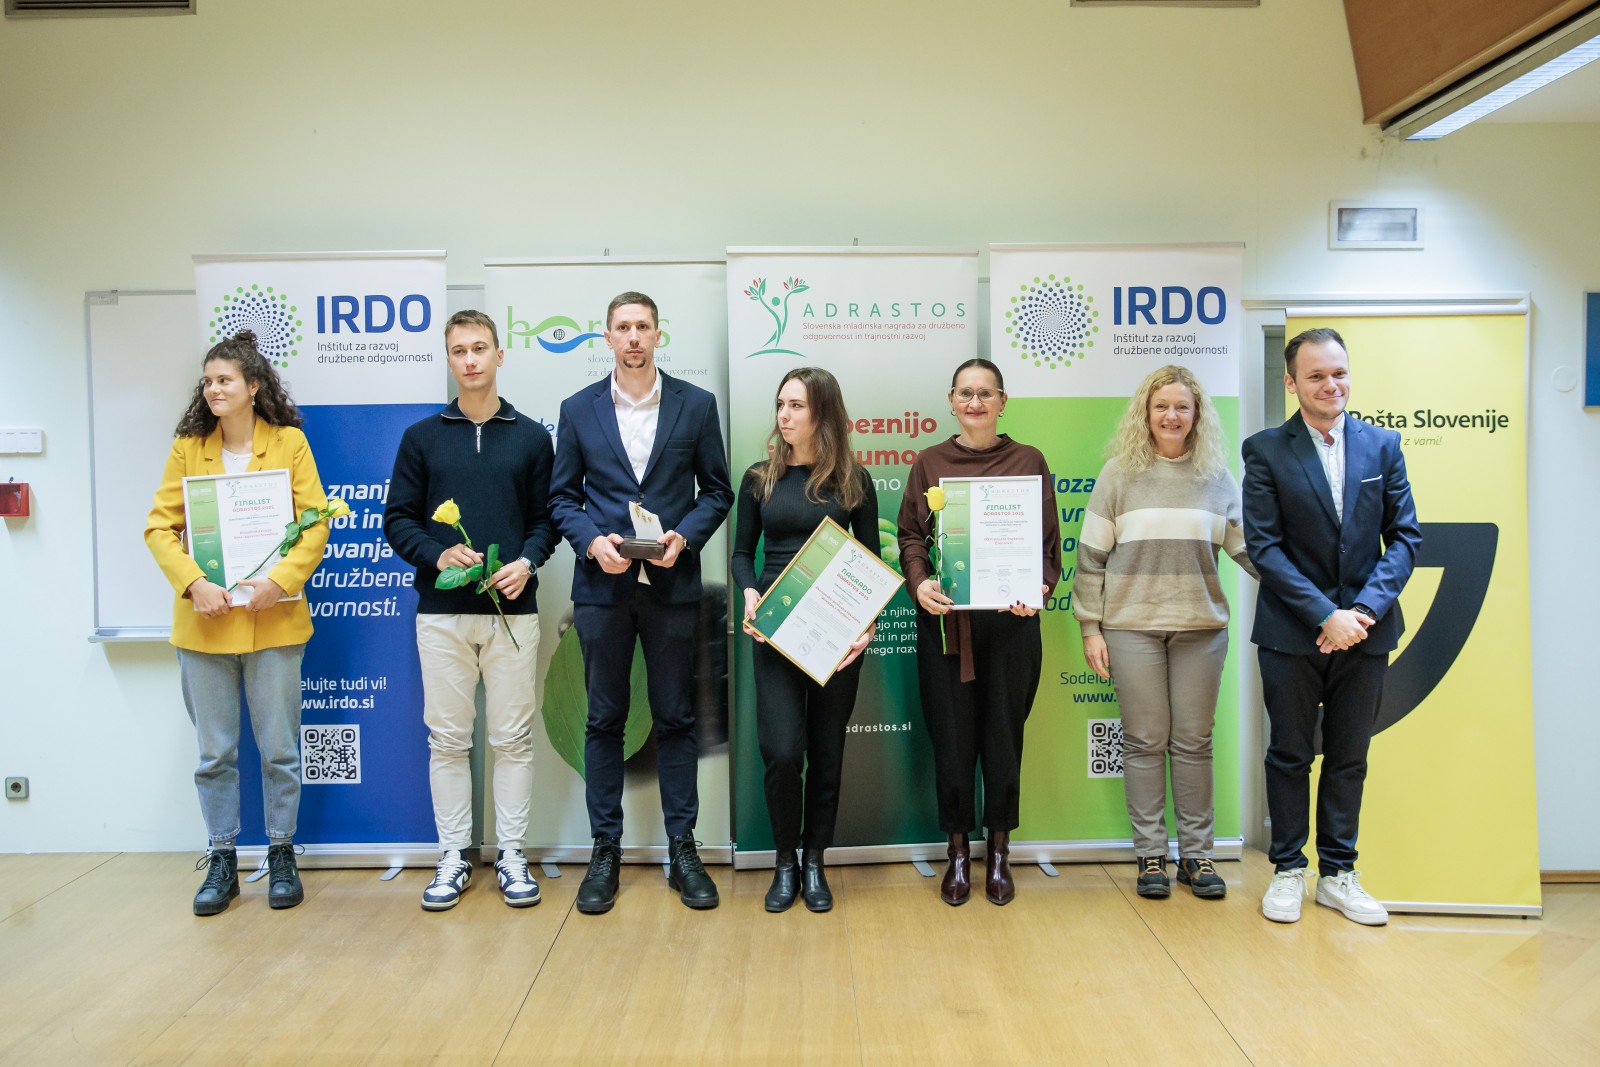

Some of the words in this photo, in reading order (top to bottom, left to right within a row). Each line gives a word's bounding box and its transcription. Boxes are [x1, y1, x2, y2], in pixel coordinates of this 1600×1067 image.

[803, 302, 966, 318] ADRASTOS
[1113, 286, 1227, 326] IRDO
[317, 294, 431, 334] IRDO
[803, 322, 841, 330] Slovenska
[843, 322, 882, 330] mladinska
[884, 322, 916, 332] nagrada
[928, 322, 966, 330] družbeno
[803, 333, 853, 341] odgovornost
[864, 333, 901, 341] trajnostni
[902, 333, 926, 341] razvoj
[1113, 333, 1149, 343] Inštitut
[1151, 335, 1163, 343] za
[1165, 333, 1196, 345] razvoj
[317, 341, 353, 352] Inštitut
[355, 343, 367, 351] za
[369, 341, 399, 352] razvoj
[1113, 345, 1162, 355] družbene
[1164, 345, 1228, 357] odgovornosti
[317, 353, 365, 364] družbene
[367, 352, 433, 365] odgovornosti
[848, 411, 937, 438] eznijo
[1349, 409, 1407, 429] Pošta
[1413, 409, 1509, 433] Slovenije
[1403, 438, 1411, 446] z
[1414, 436, 1443, 446] vami!
[327, 479, 391, 504] znanj
[234, 498, 271, 507] FINALIST
[362, 508, 383, 529] in
[322, 537, 393, 563] ovanja
[311, 568, 415, 588] družbene
[841, 568, 873, 595] NAGRADO
[309, 597, 401, 617] vornosti.
[890, 607, 917, 618] njiho
[893, 621, 907, 629] na
[888, 632, 898, 642] in
[900, 631, 917, 643] pris
[896, 646, 917, 654] razv
[301, 677, 337, 693] elujte
[340, 677, 367, 690] tudi
[371, 676, 387, 690] vi!
[1060, 671, 1113, 686] Sodeluj
[301, 695, 374, 709] ww.irdo.si
[1073, 692, 1117, 703] www.
[846, 722, 912, 733] adrastos.si
